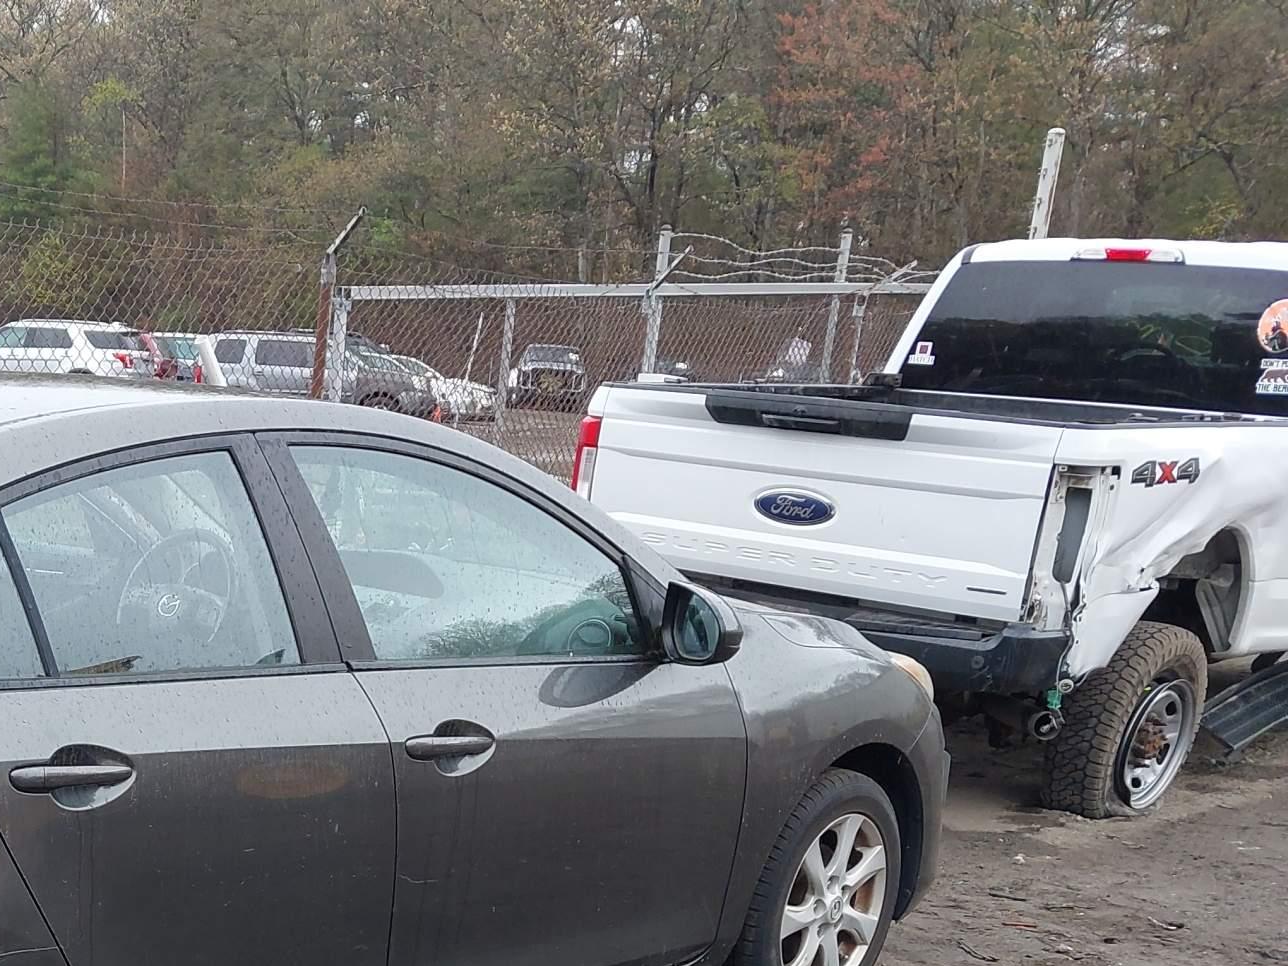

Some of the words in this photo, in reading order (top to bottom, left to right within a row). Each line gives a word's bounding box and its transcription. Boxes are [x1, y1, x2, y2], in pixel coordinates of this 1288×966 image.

[1257, 383, 1272, 393] THE
[770, 494, 817, 519] Ford
[640, 531, 797, 567] SUPER
[810, 556, 948, 588] DUTY
